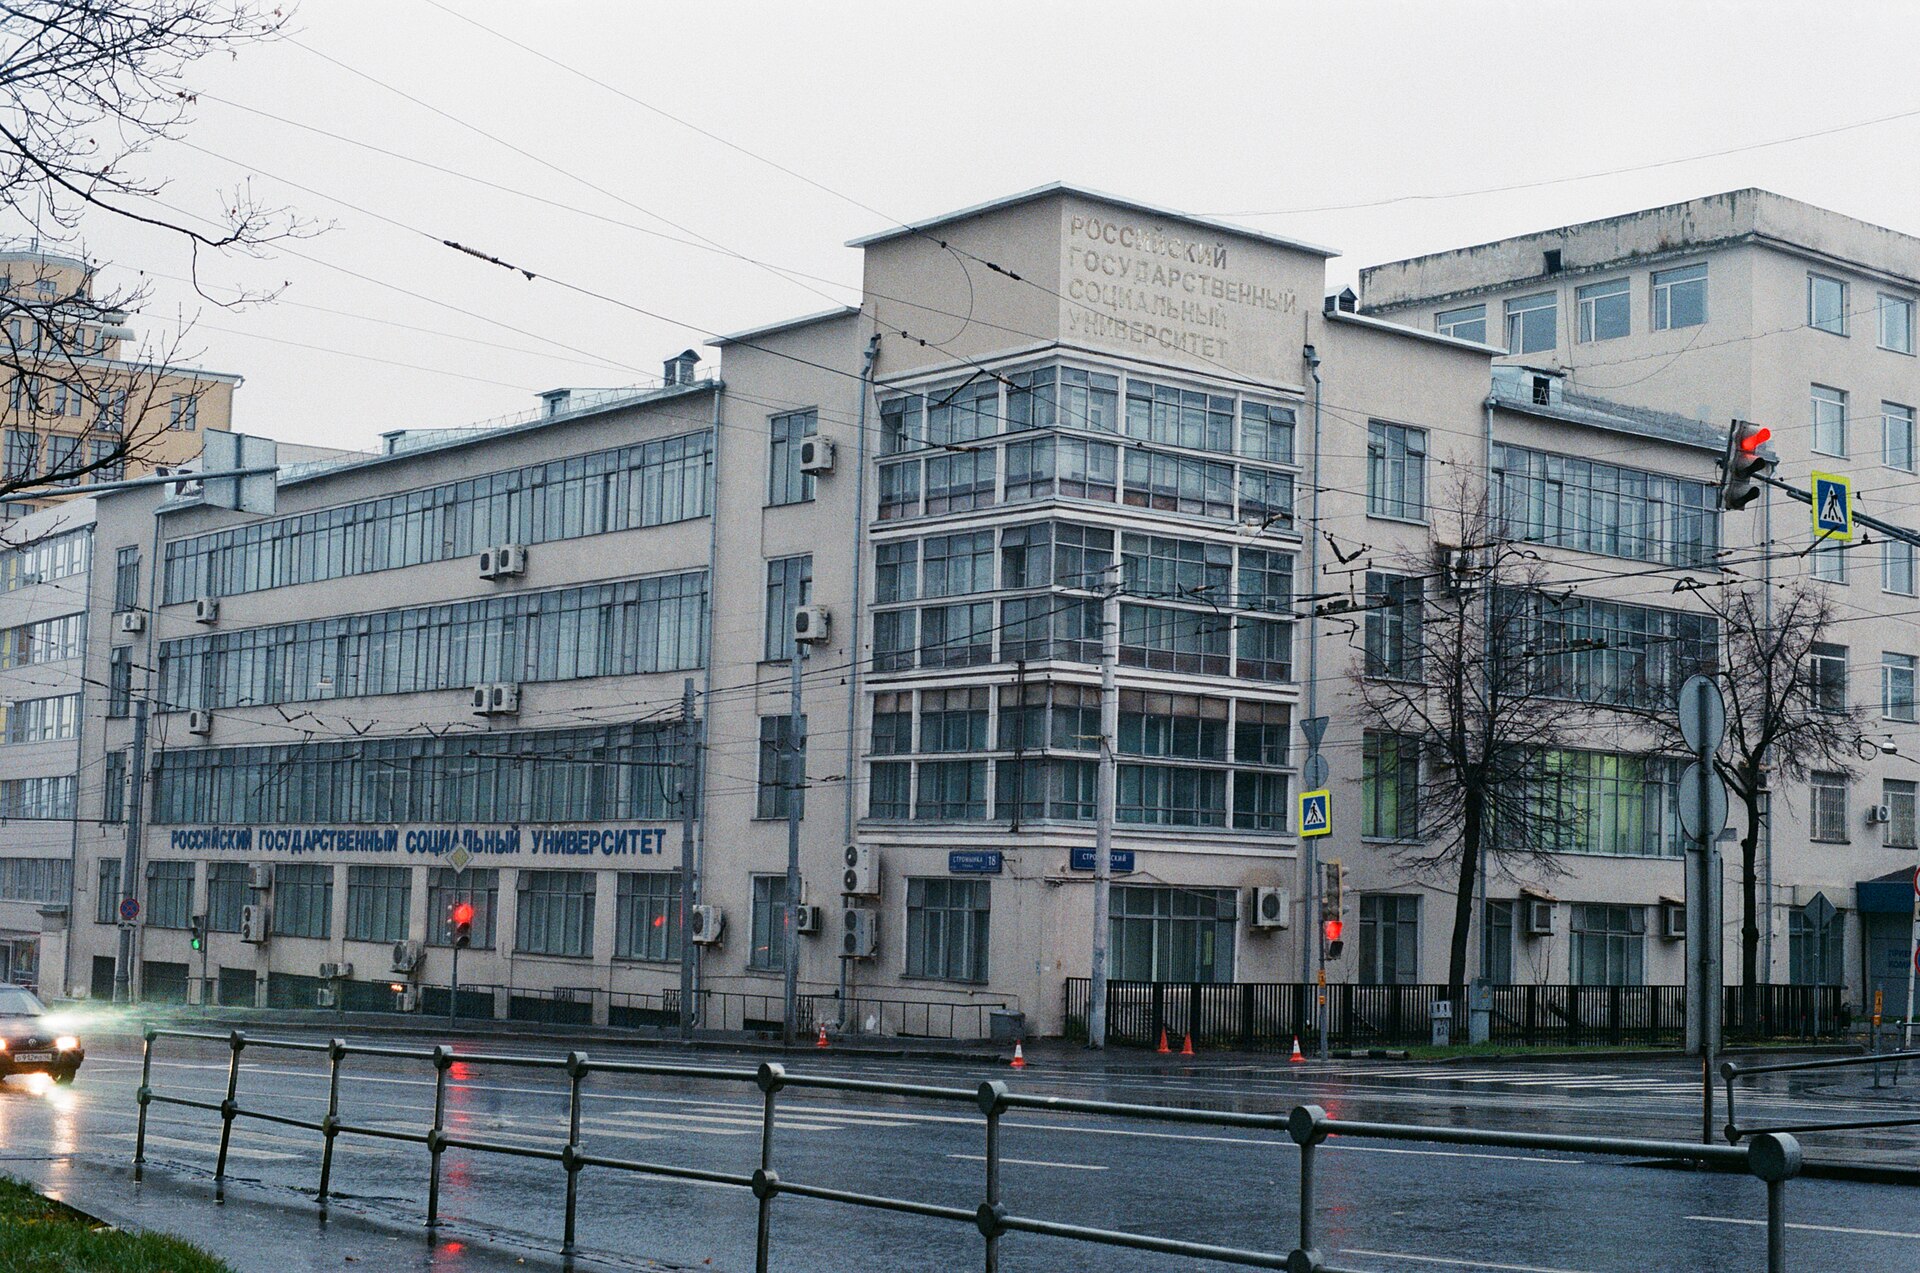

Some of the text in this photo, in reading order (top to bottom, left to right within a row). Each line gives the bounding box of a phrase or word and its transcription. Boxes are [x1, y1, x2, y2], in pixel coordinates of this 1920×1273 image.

[1070, 214, 1227, 270] РОССИЙСКИЙ
[1068, 246, 1297, 315] ГОСУДАРСТВЕННЫЙ
[1068, 278, 1228, 330] СОЦИАЛЬНЫЙ
[1068, 308, 1229, 359] УНИВЕРСИТЕТ
[171, 827, 253, 850] РОССИЙСКИЙ
[258, 828, 399, 854] ГОСУДАРСТВЕННЫЙ
[531, 829, 667, 855] УНИВЕРСИТЕТ
[988, 855, 997, 866] 18
